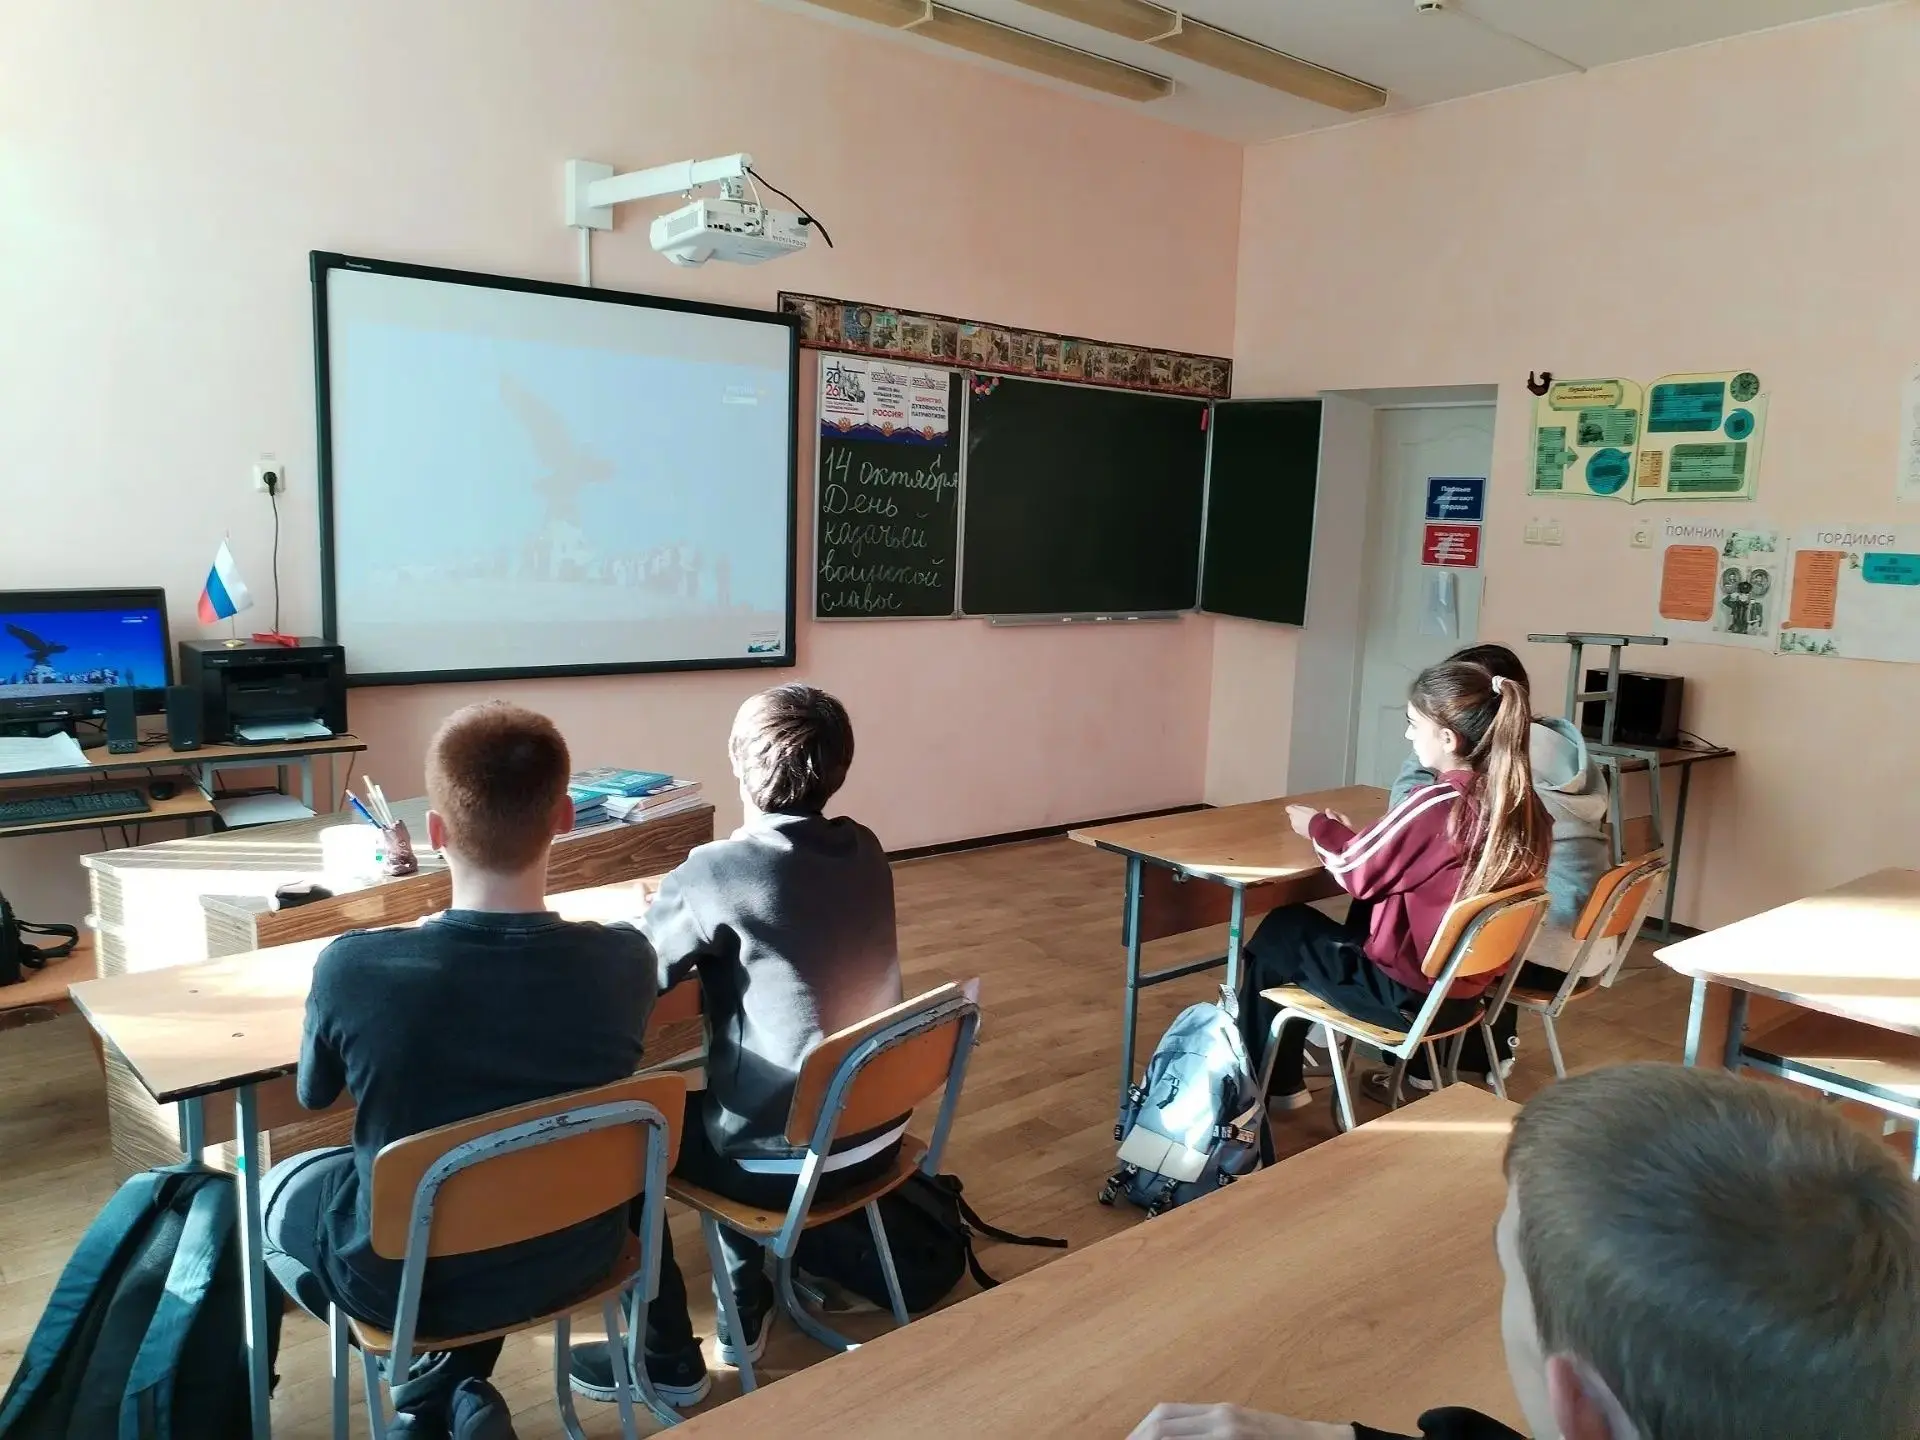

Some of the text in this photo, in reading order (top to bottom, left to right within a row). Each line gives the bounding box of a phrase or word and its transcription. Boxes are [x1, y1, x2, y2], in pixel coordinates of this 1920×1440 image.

[826, 371, 841, 384] 20
[825, 447, 852, 483] 14
[822, 484, 899, 518] День
[1666, 525, 1724, 539] ПОМНИМ
[1816, 532, 1896, 546] ГОРДИМСЯ
